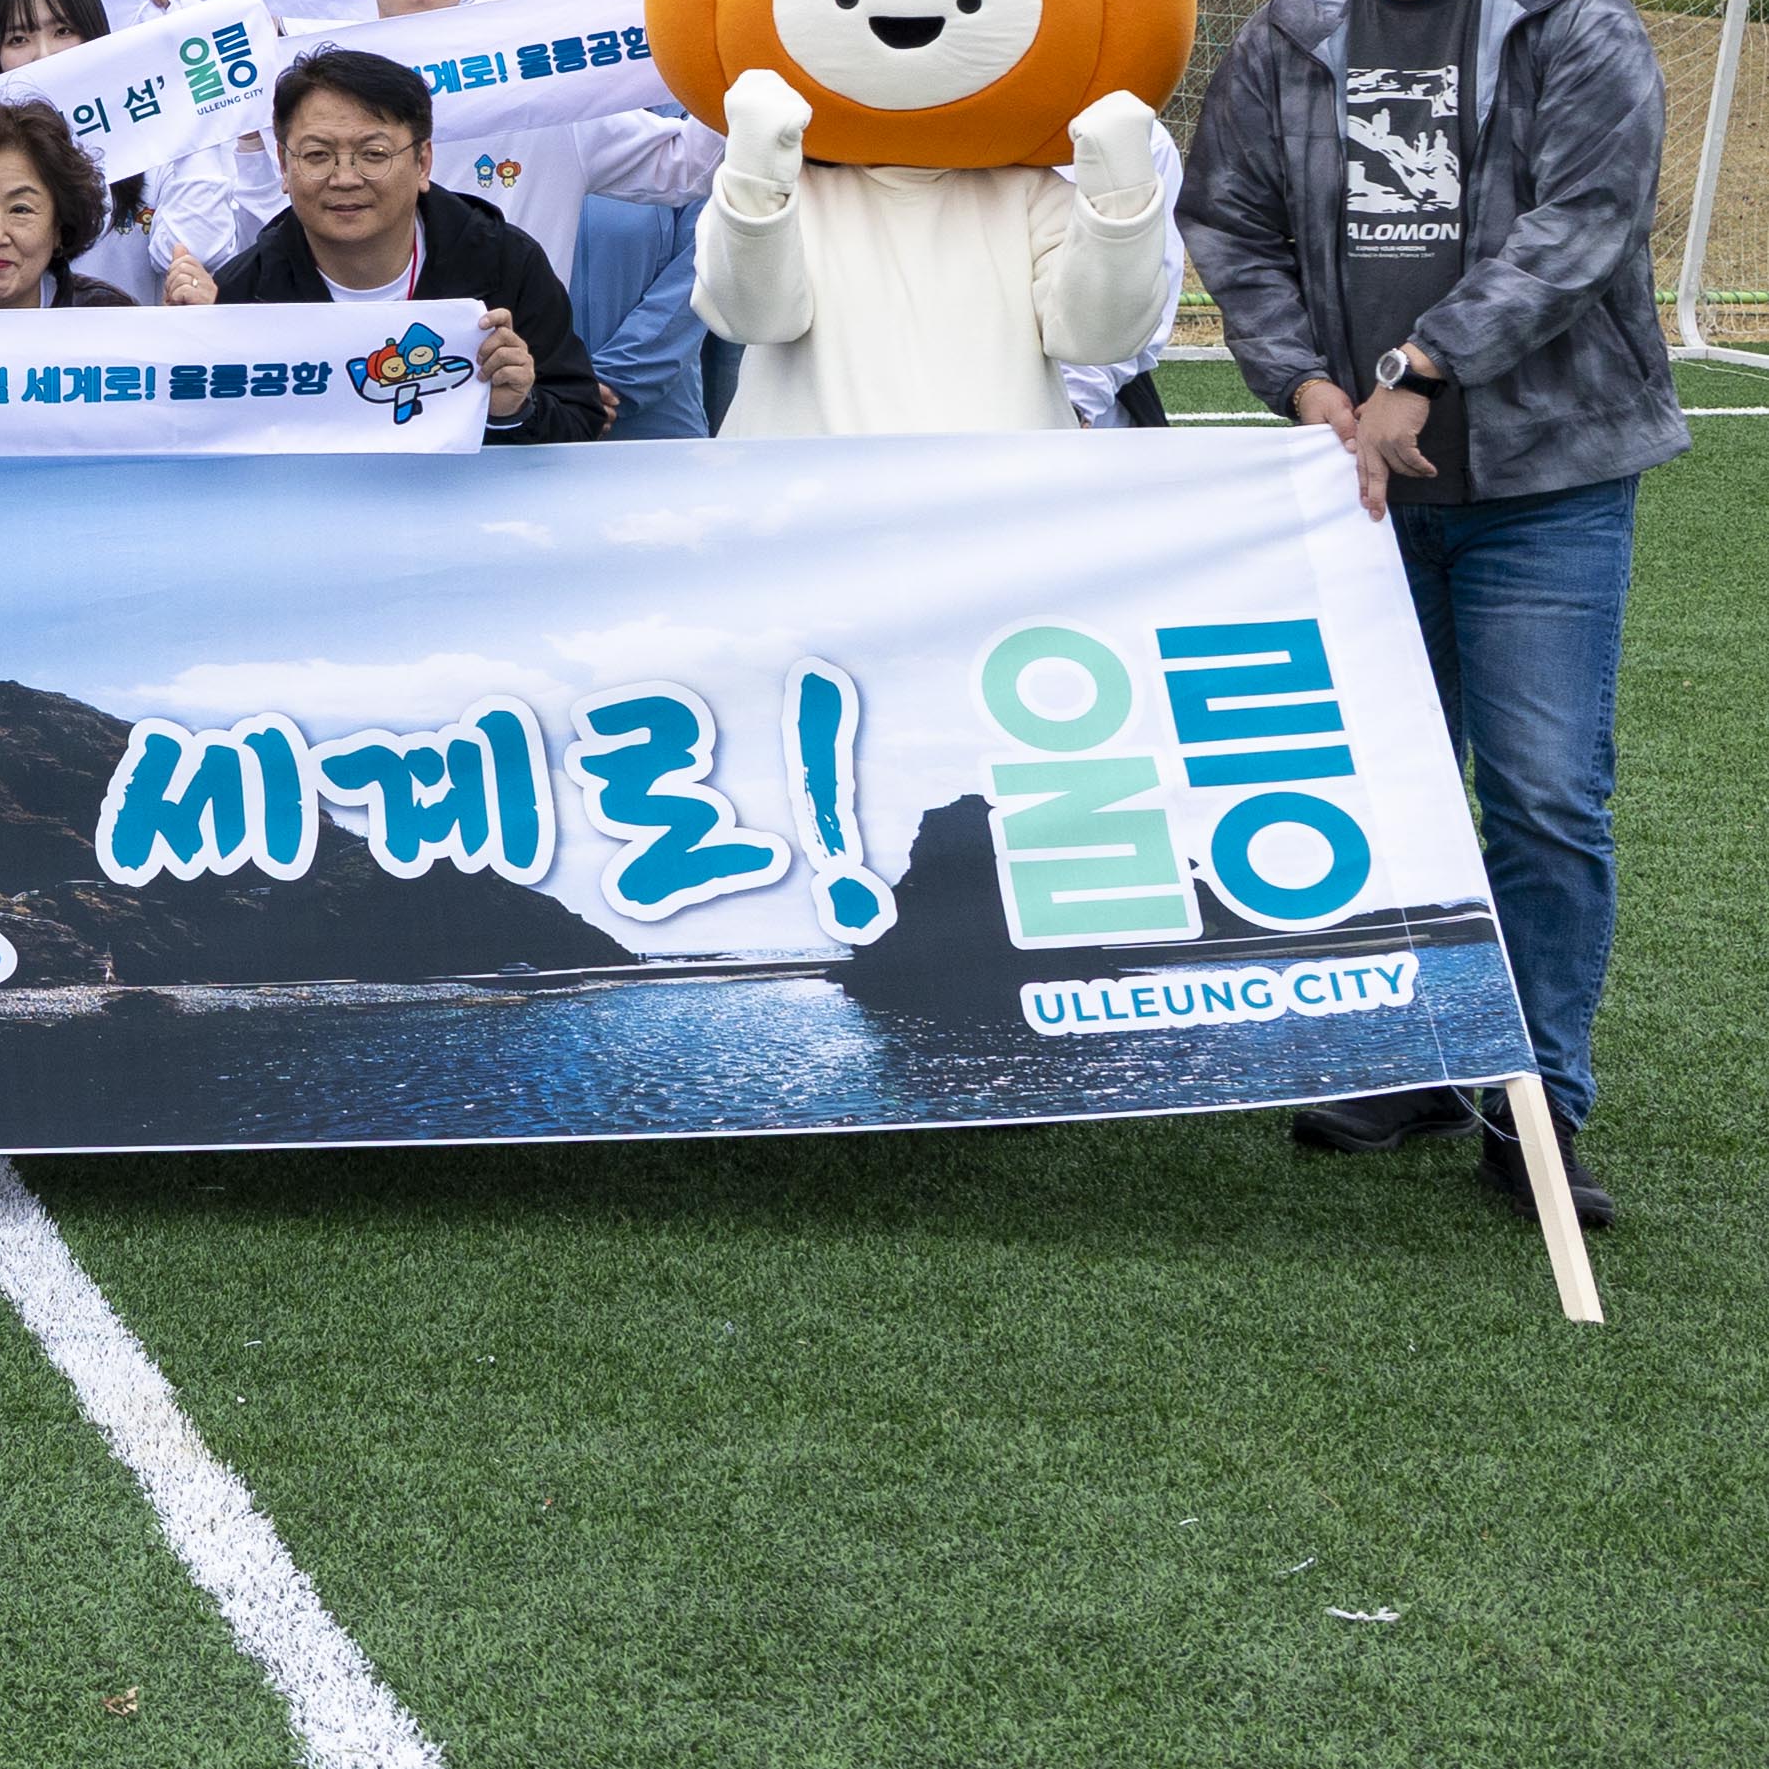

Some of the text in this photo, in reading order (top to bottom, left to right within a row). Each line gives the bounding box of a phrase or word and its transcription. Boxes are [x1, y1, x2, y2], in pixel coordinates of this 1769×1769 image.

[180, 21, 258, 104] 울릉
[422, 52, 510, 100] 계로!
[196, 85, 264, 116] ULLEUNG CITY
[1347, 222, 1461, 241] ALOMON
[21, 366, 158, 405] 세계로!
[169, 362, 335, 402] 울릉공항
[97, 659, 895, 942] 세계로!
[979, 615, 1373, 940] 울릉
[1032, 962, 1406, 1025] ULLEUNG CITY
